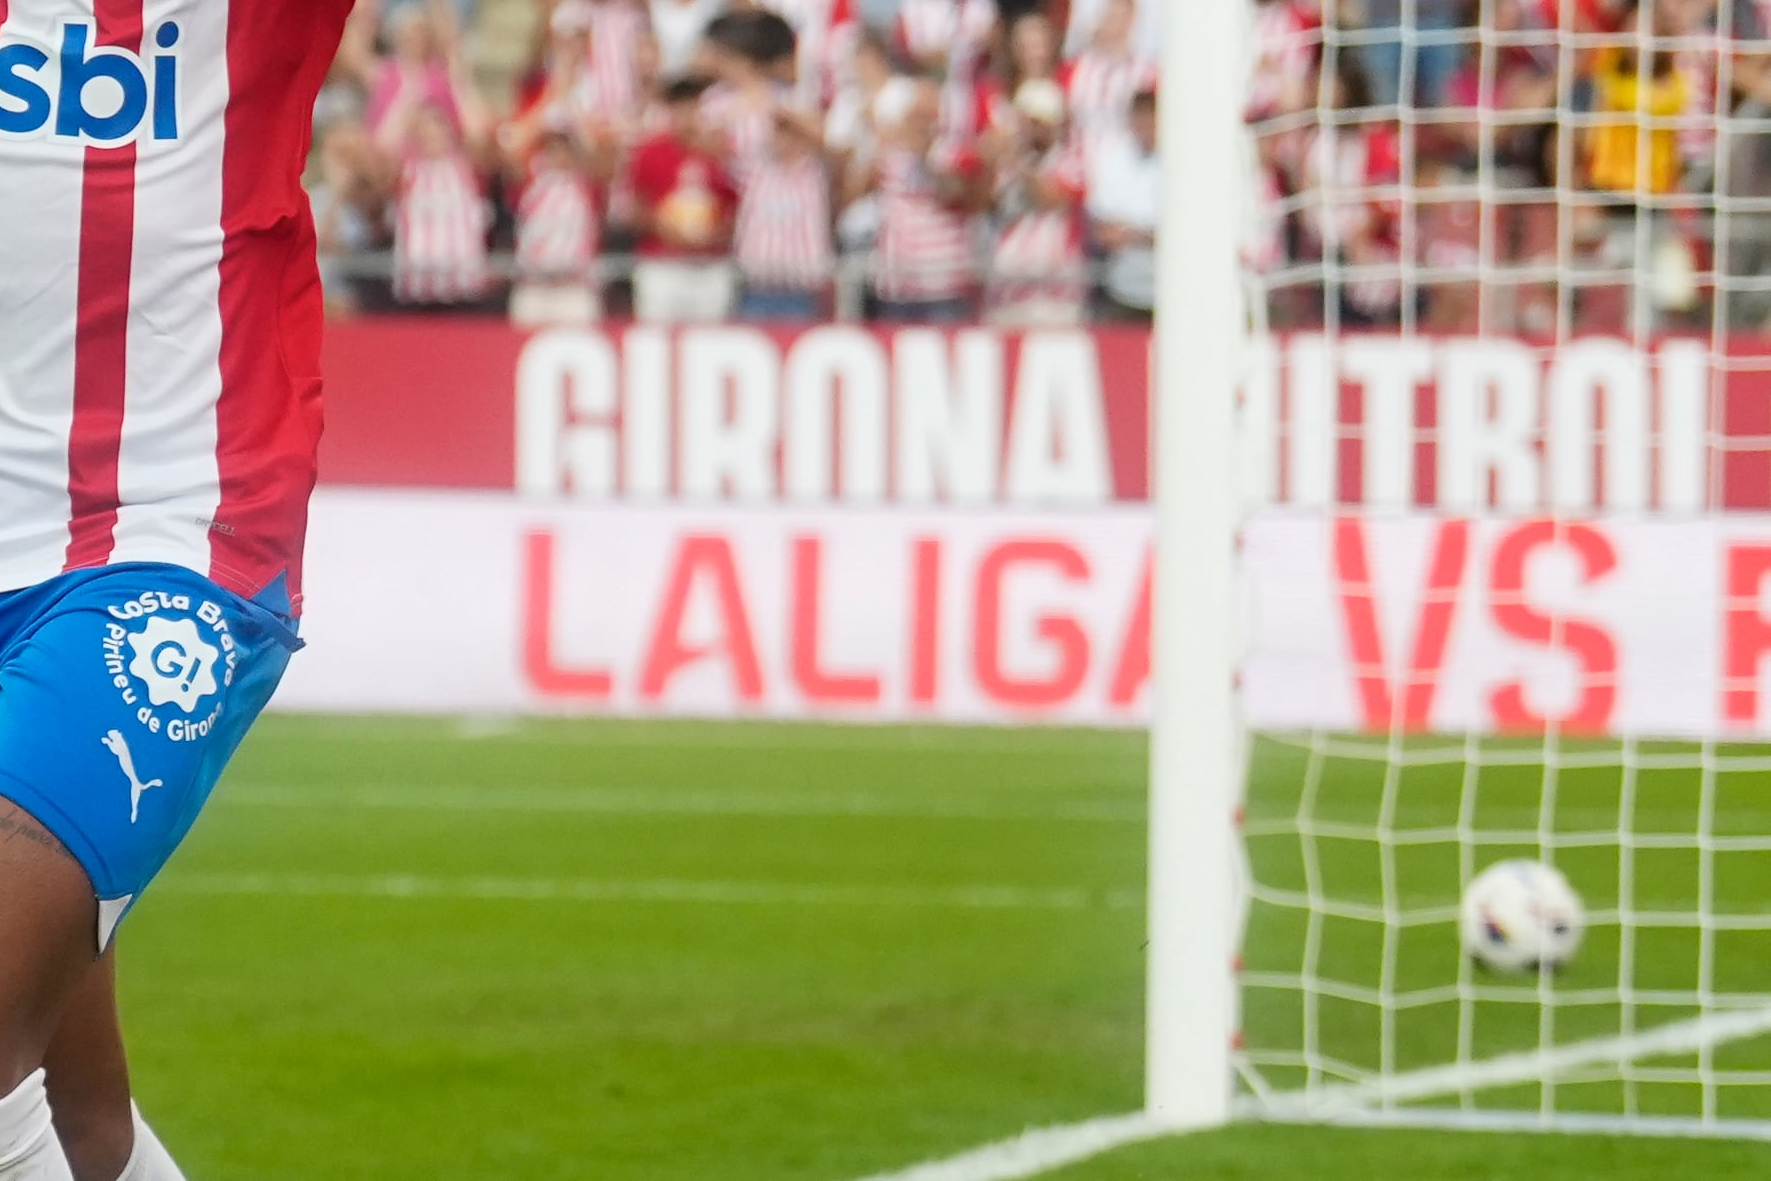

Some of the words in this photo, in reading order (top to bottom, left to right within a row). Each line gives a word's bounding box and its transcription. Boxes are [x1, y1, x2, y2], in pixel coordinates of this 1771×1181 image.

[514, 325, 1116, 503] GIRONA
[107, 591, 190, 620] Costa
[1331, 516, 1619, 736] VS
[102, 623, 137, 705] Pirineu
[137, 707, 160, 733] de
